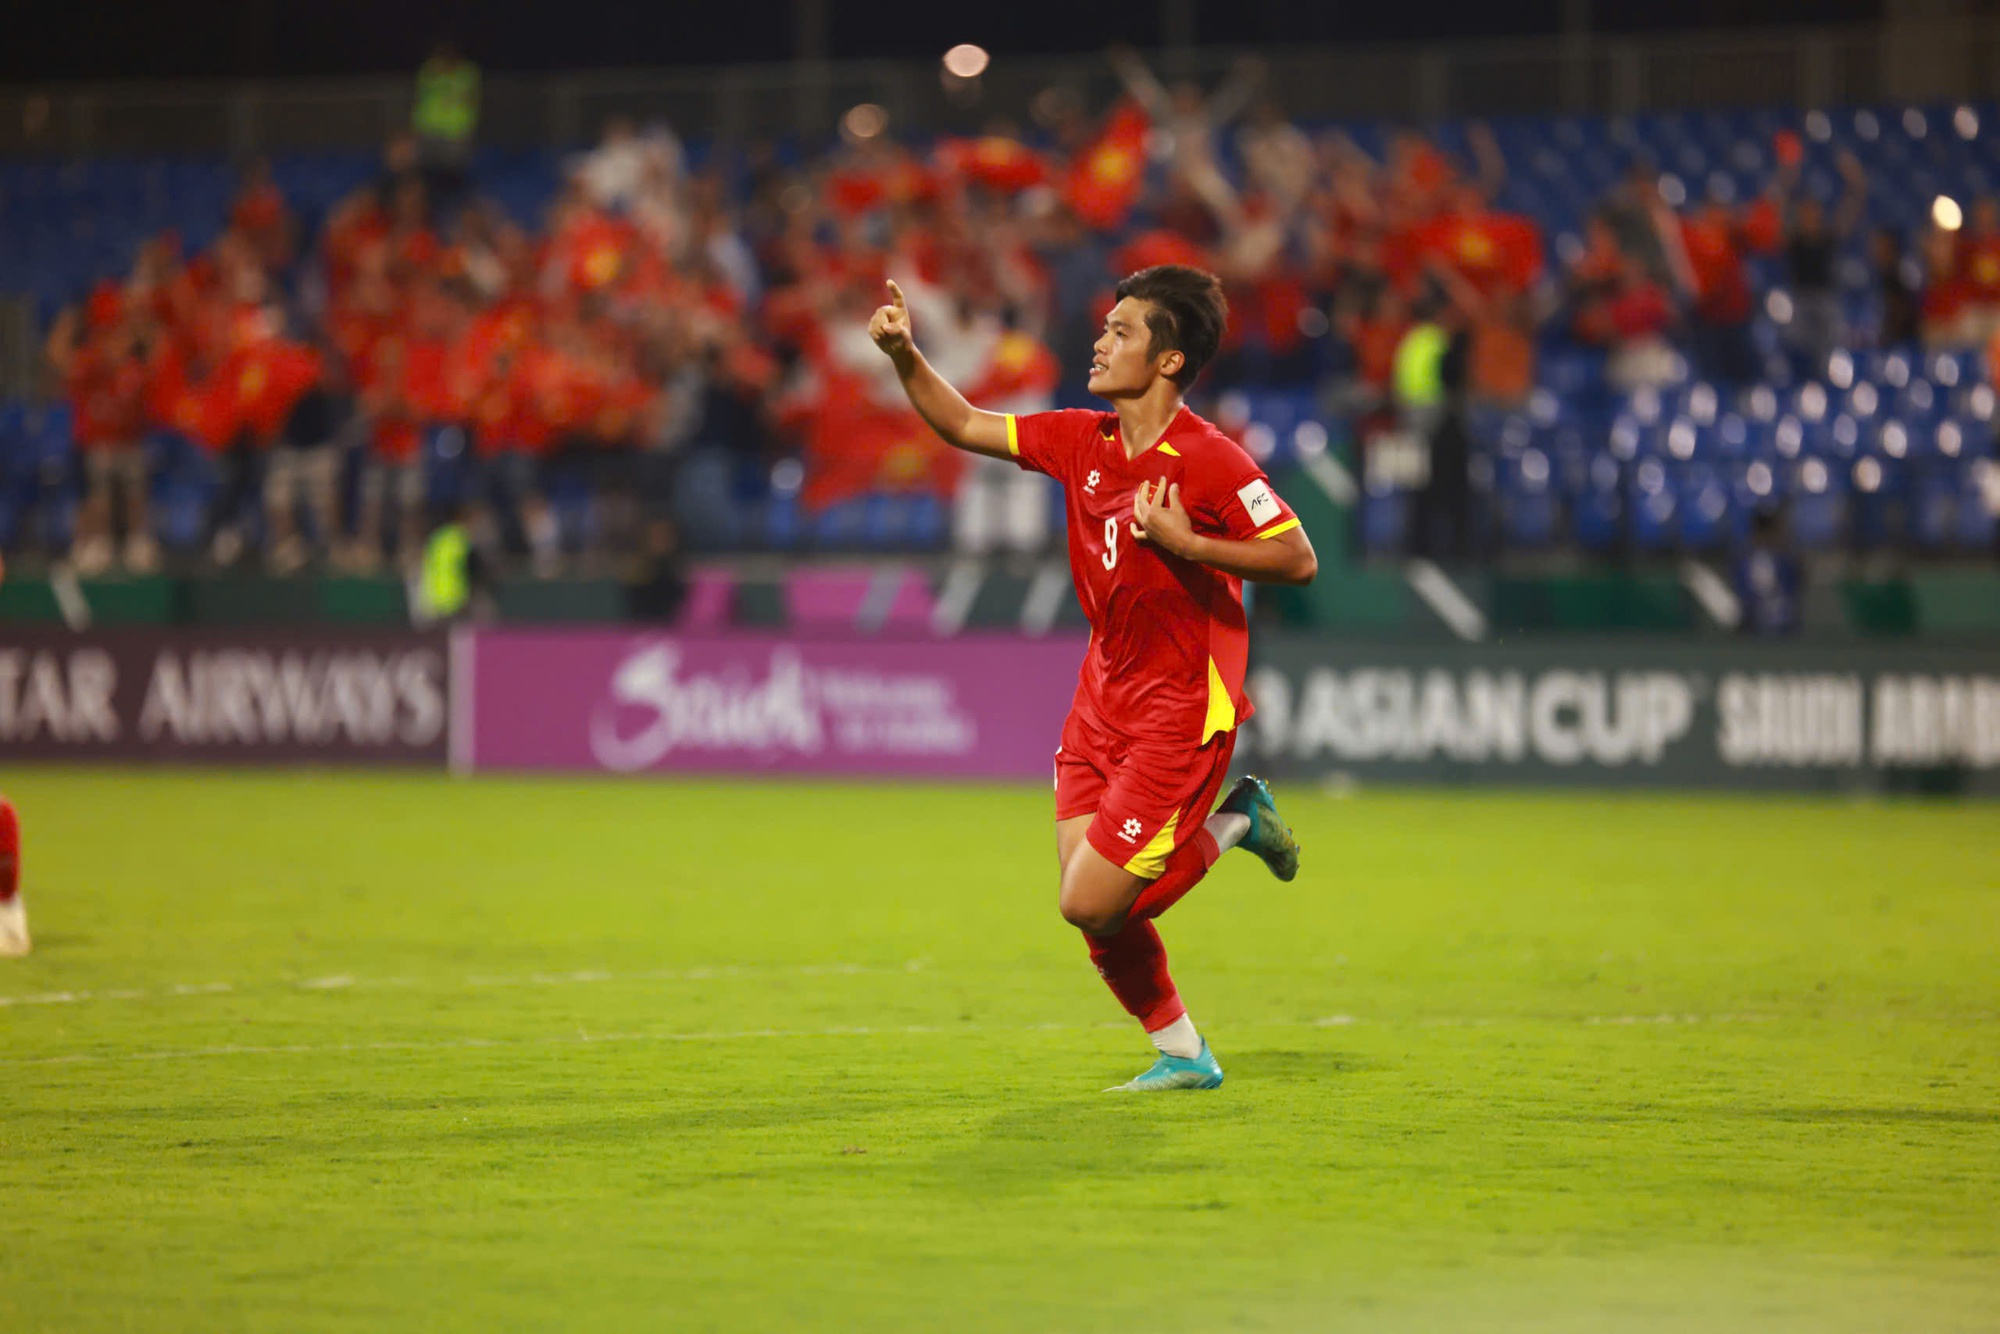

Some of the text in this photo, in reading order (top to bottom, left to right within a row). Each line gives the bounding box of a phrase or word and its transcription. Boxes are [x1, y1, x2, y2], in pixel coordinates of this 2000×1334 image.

[1251, 492, 1269, 511] AFC
[1102, 517, 1118, 571] 9
[138, 648, 443, 745] AIRWAYS
[1300, 667, 1525, 760] ASIAN
[1532, 668, 1694, 765] CUP
[1717, 671, 1862, 766] SAUDI
